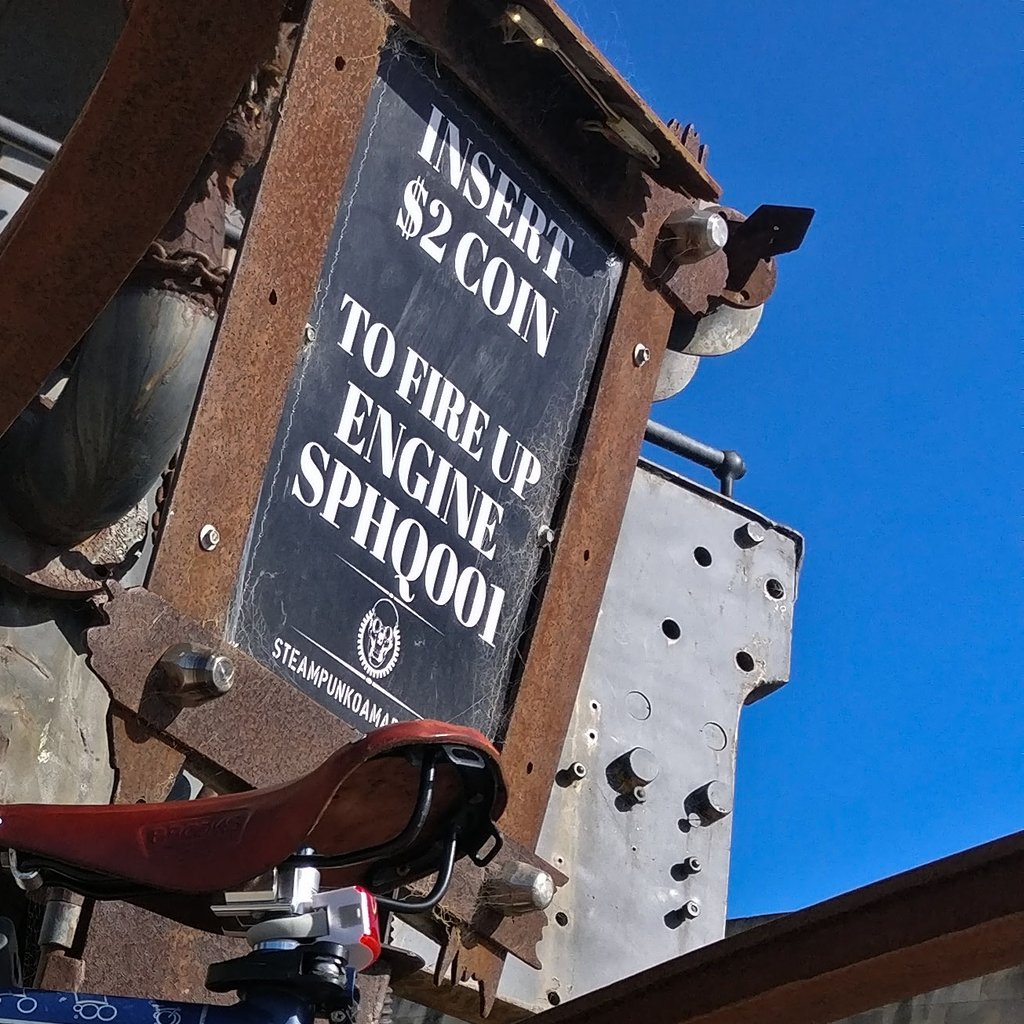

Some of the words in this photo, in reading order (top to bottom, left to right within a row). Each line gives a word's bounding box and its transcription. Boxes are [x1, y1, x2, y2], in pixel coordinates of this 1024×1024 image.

[396, 175, 453, 264] $2
[454, 232, 560, 358] COIN
[417, 103, 575, 284] INSERT
[334, 381, 505, 561] ENGINE
[337, 293, 396, 378] TO
[396, 346, 490, 461] FIRE
[491, 425, 541, 500] UP
[292, 441, 506, 648] SPHQ001
